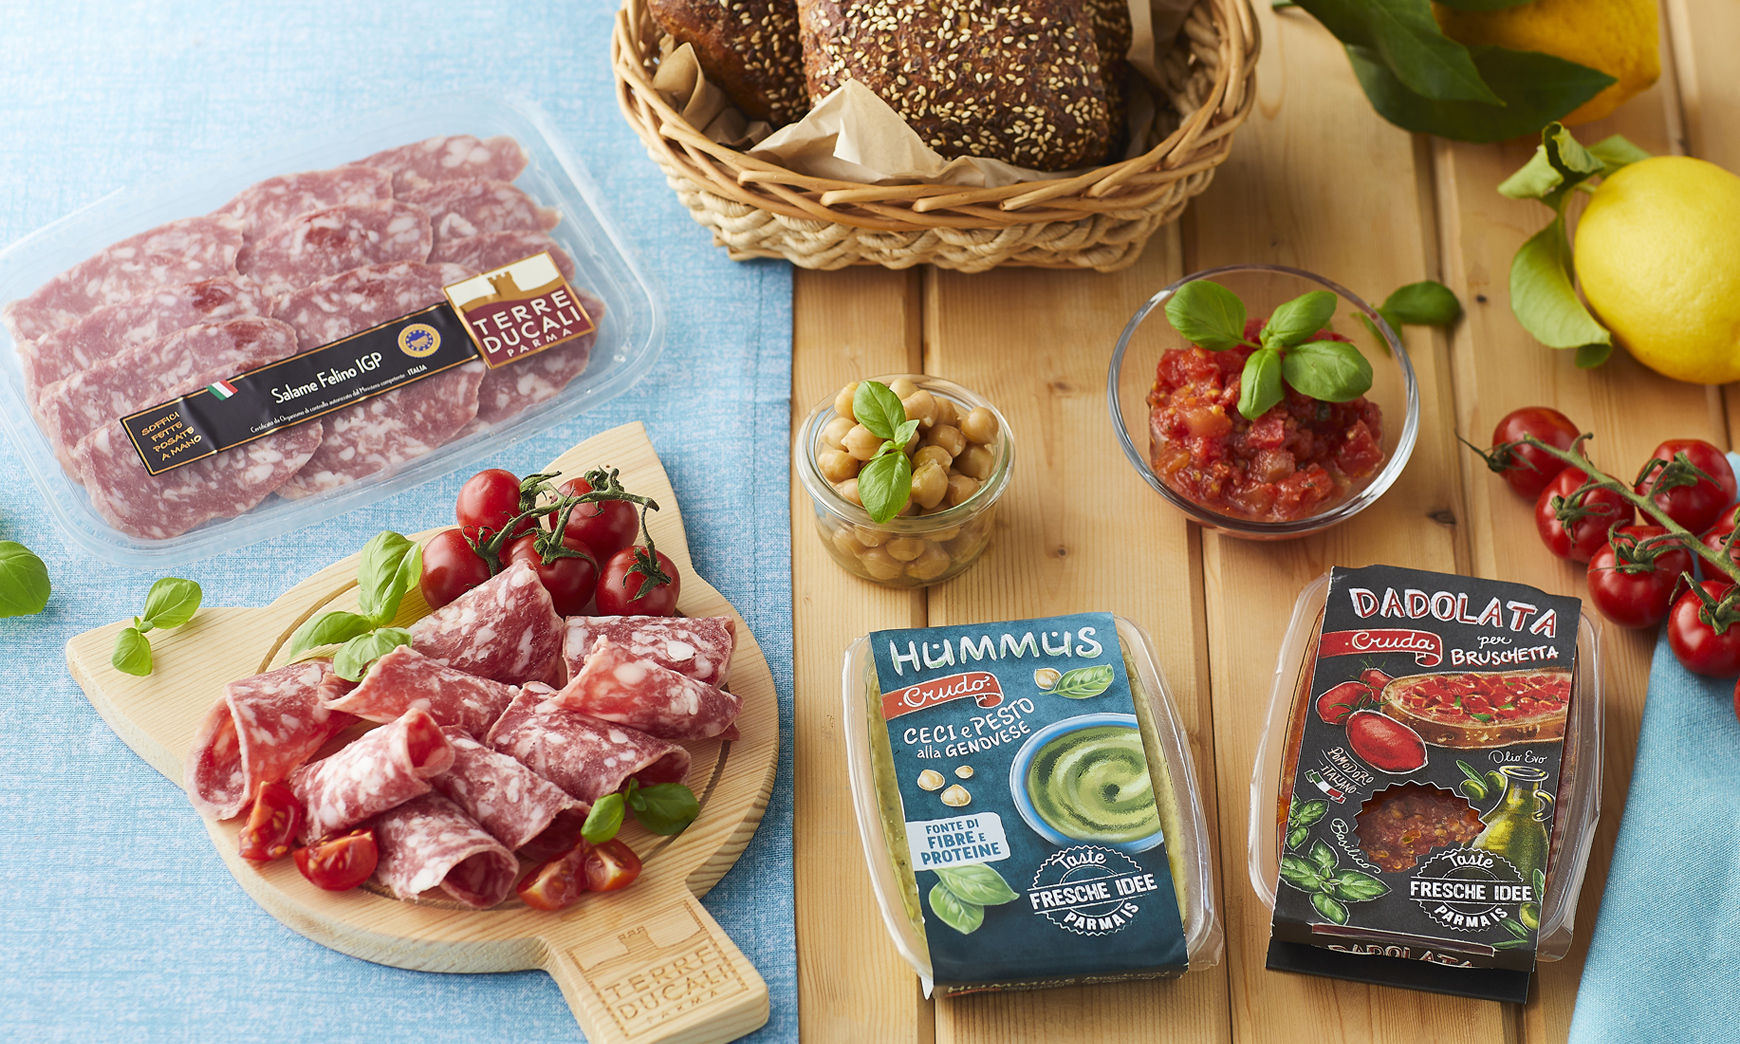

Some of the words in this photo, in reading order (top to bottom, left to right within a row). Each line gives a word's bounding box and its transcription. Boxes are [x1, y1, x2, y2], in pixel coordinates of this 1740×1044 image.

[472, 290, 571, 335] TERRE
[482, 306, 581, 354] DUCALI
[507, 328, 572, 357] PARMA
[271, 384, 319, 404] Salame
[316, 368, 358, 388] Felino
[355, 352, 383, 374] IGP
[407, 364, 428, 376] ITALIA
[141, 411, 180, 436] SOFFICI
[151, 421, 183, 442] FETTE
[153, 426, 195, 452] POSATE
[161, 453, 171, 461] A
[170, 434, 202, 456] MANO
[1348, 587, 1557, 639] DADOLATA
[1351, 632, 1435, 650] Cruda
[1477, 635, 1512, 649] per
[1450, 646, 1560, 667] BRUSCHETTA
[903, 675, 991, 708] Crudo
[903, 724, 958, 745] CECI
[960, 726, 972, 738] e
[969, 697, 1035, 736] PESTO
[916, 744, 942, 759] alla
[945, 720, 1031, 758] GENOVESE
[1488, 750, 1522, 764] Olio
[1523, 750, 1548, 764] Evo
[925, 822, 967, 835] FONTE
[967, 819, 980, 829] DI
[927, 830, 975, 849] FIBRE
[978, 832, 986, 842] E
[920, 842, 1001, 866] PROTEINE
[1330, 818, 1381, 874] Basilico
[1051, 849, 1107, 871] Taste
[1442, 852, 1494, 869] Taste
[1029, 882, 1111, 910] FRESCHE
[1115, 873, 1159, 896] IDEE
[1410, 880, 1487, 900] FRESCHE
[1494, 885, 1532, 901] IDEE
[1063, 911, 1126, 931] PARMA
[1123, 902, 1140, 919] IS
[1434, 904, 1492, 928] PARMA
[1490, 908, 1508, 922] IS
[604, 946, 713, 999] TERRE
[617, 964, 730, 1021] DUCALI
